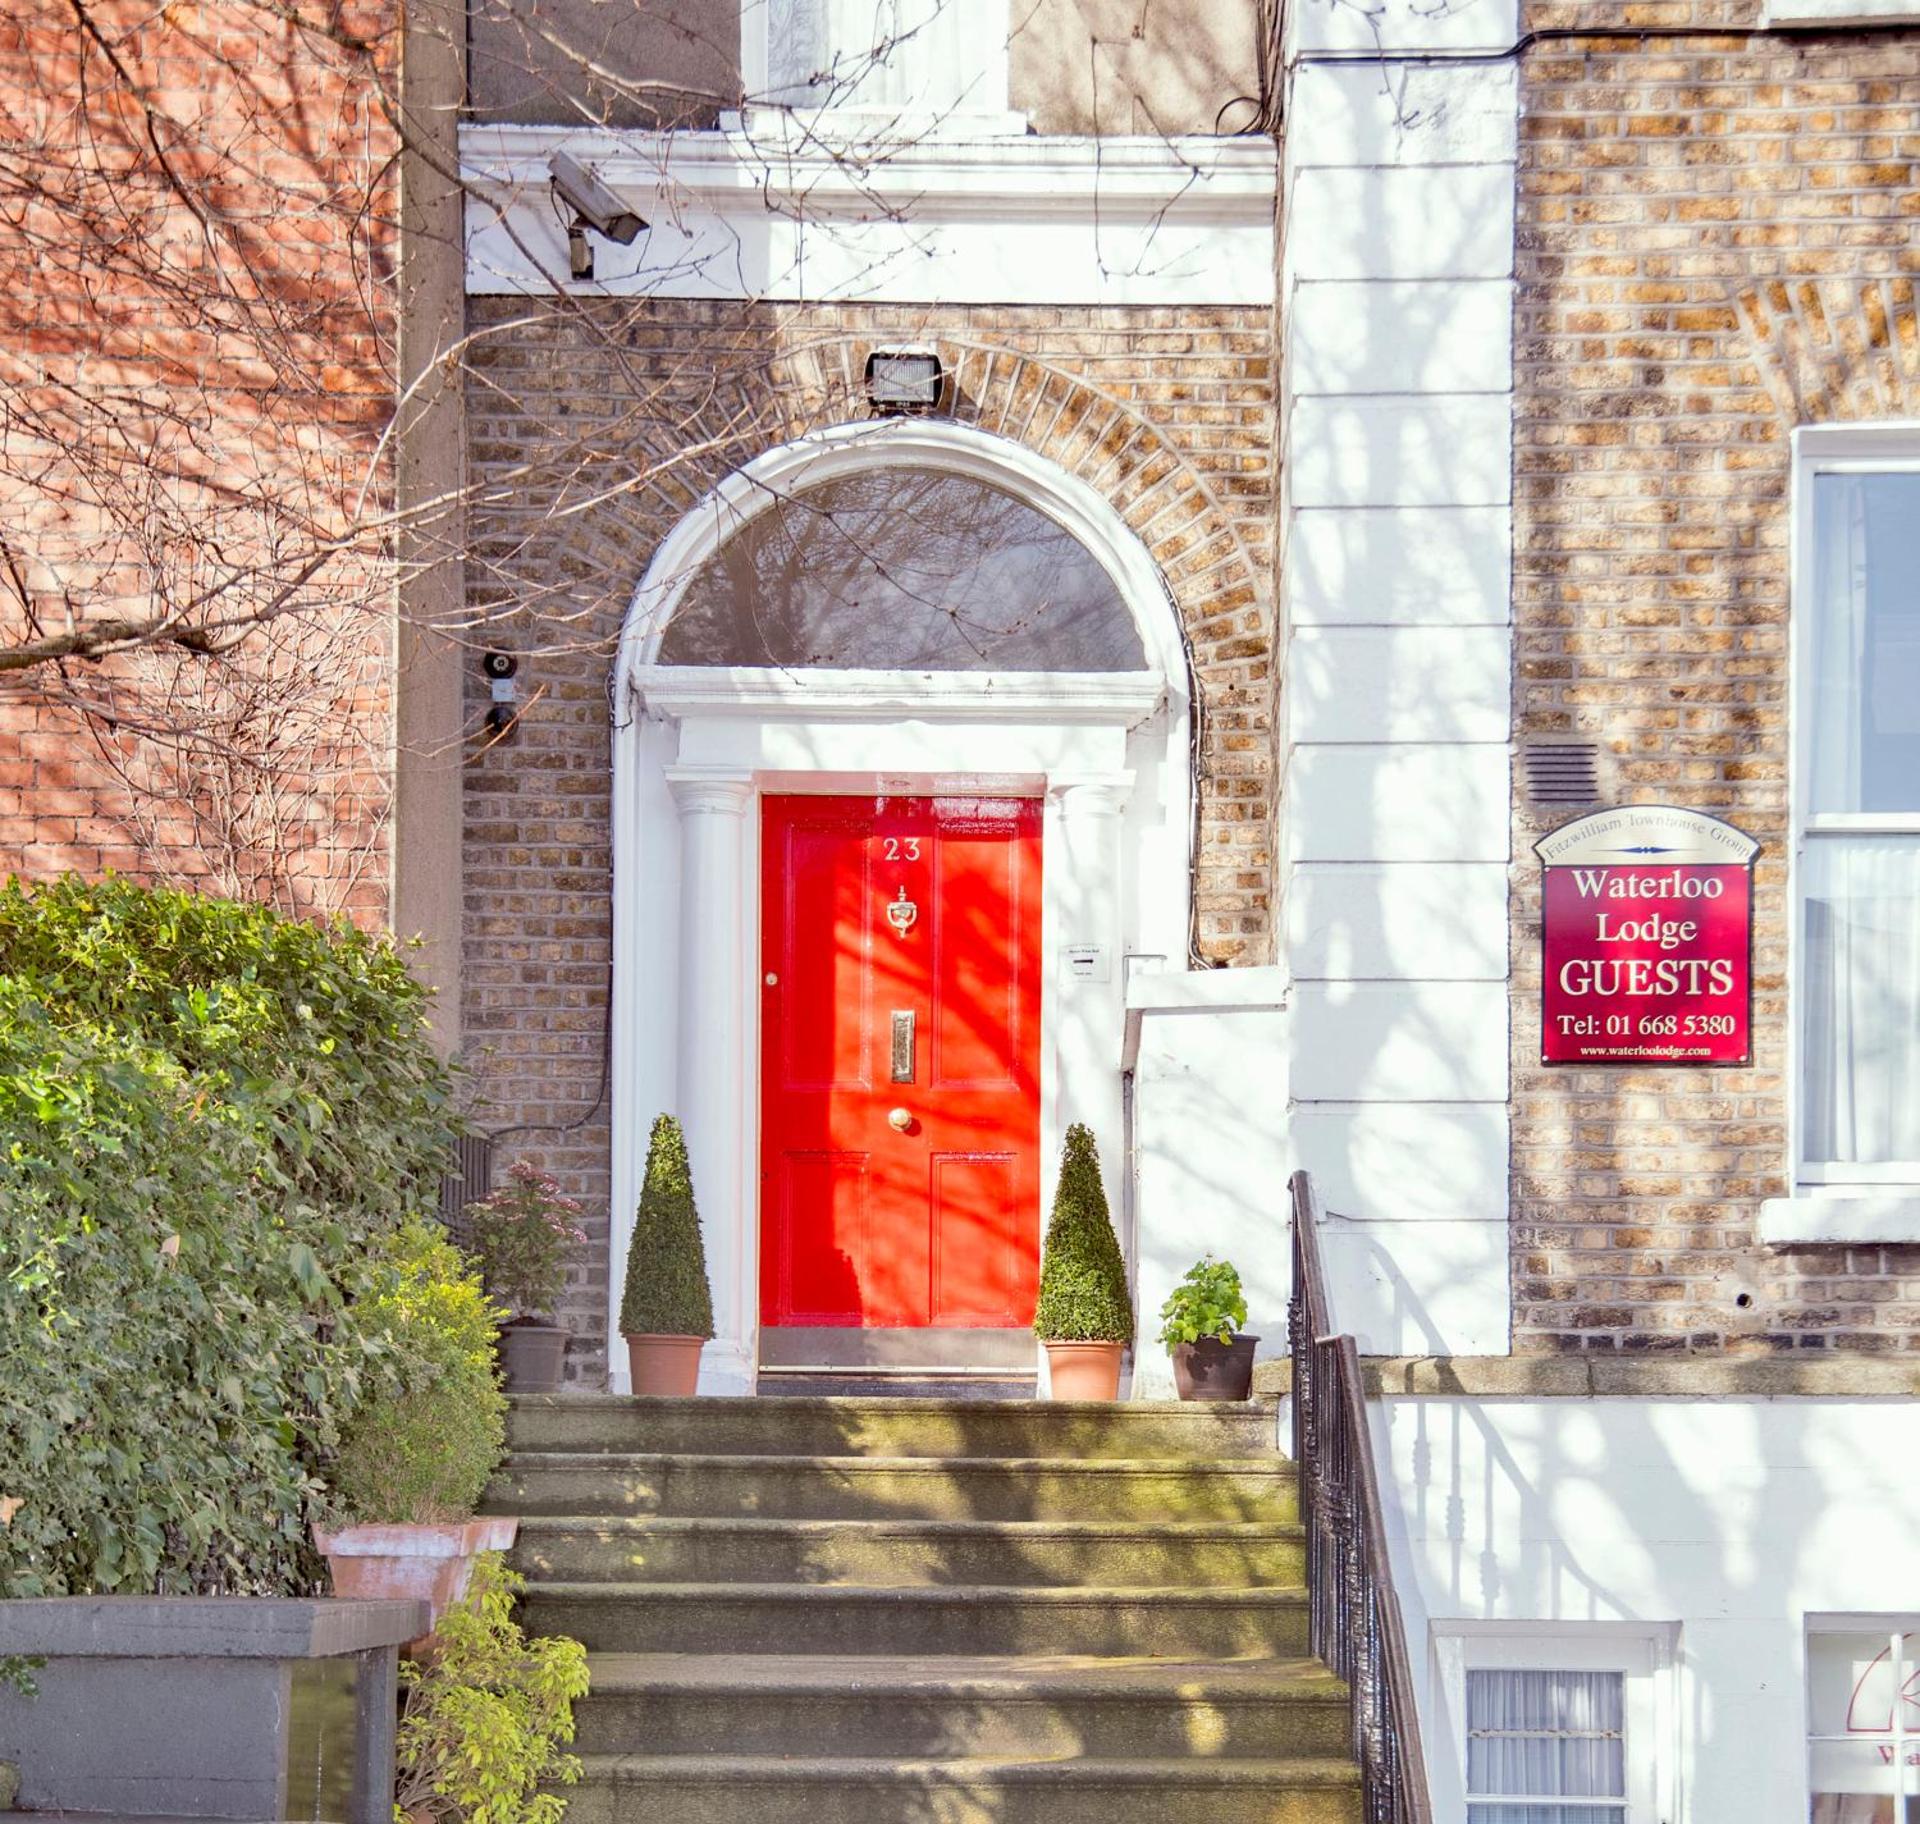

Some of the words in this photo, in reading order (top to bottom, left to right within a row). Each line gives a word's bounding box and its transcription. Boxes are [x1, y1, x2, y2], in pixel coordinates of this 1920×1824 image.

[883, 837, 920, 861] 23
[1544, 818, 1622, 859] Fitzwilliam
[1710, 827, 1751, 858] Group
[1572, 869, 1723, 899] Waterloo
[1596, 913, 1697, 950] Lodge
[1559, 959, 1734, 996] GUESTS
[1556, 1014, 1600, 1035] Tel:
[1606, 1014, 1631, 1035] 01
[1638, 1014, 1678, 1035] 668
[1682, 1014, 1736, 1035] 5380
[1580, 1045, 1712, 1059] www.waterloolodge.com
